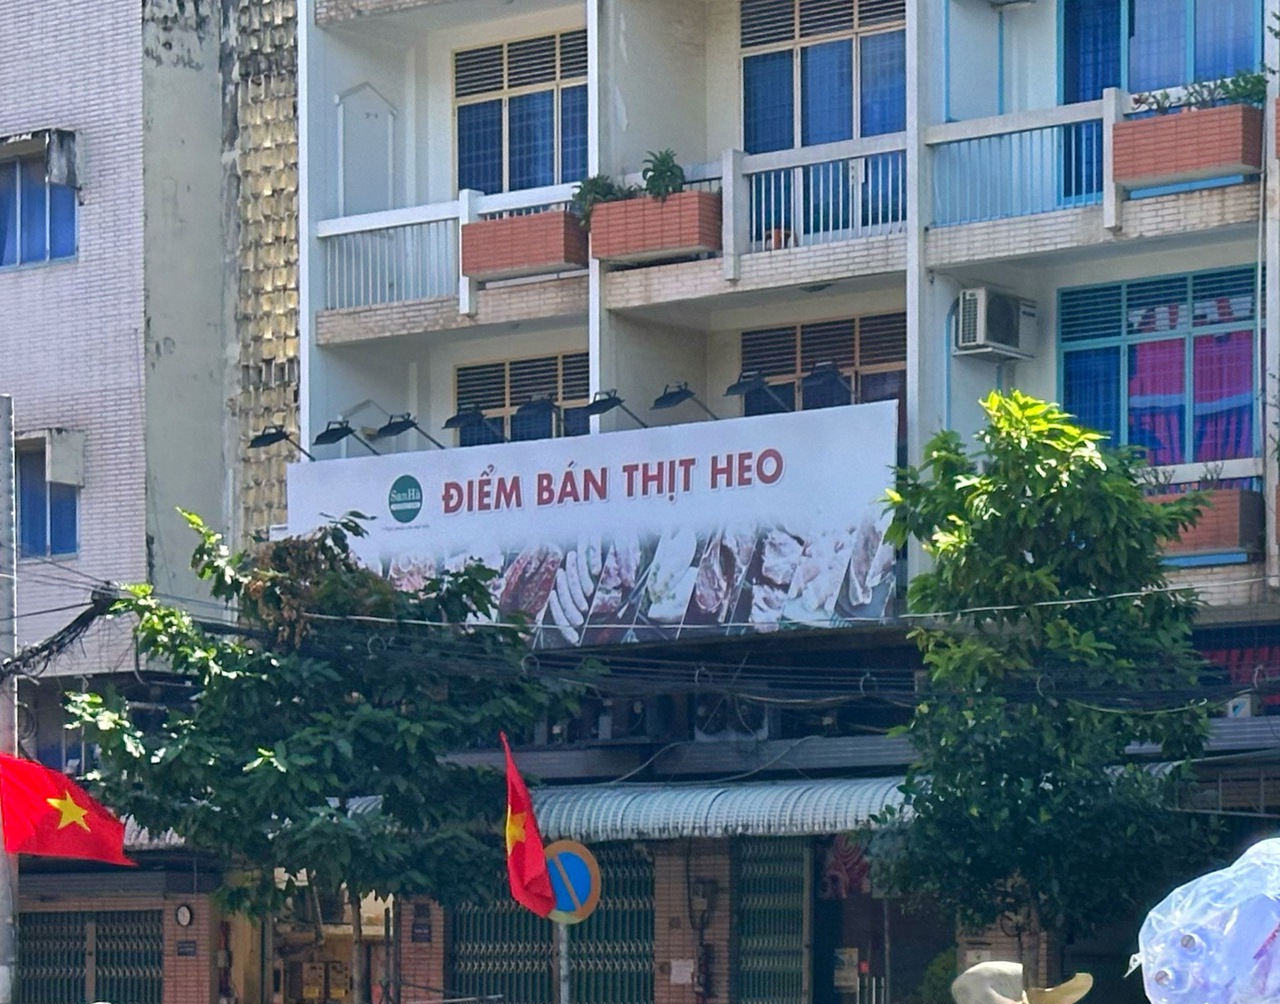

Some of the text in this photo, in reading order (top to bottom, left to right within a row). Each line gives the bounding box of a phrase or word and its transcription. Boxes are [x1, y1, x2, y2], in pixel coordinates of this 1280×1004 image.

[442, 448, 785, 515] ĐIỂM BÁN THỊT HEO
